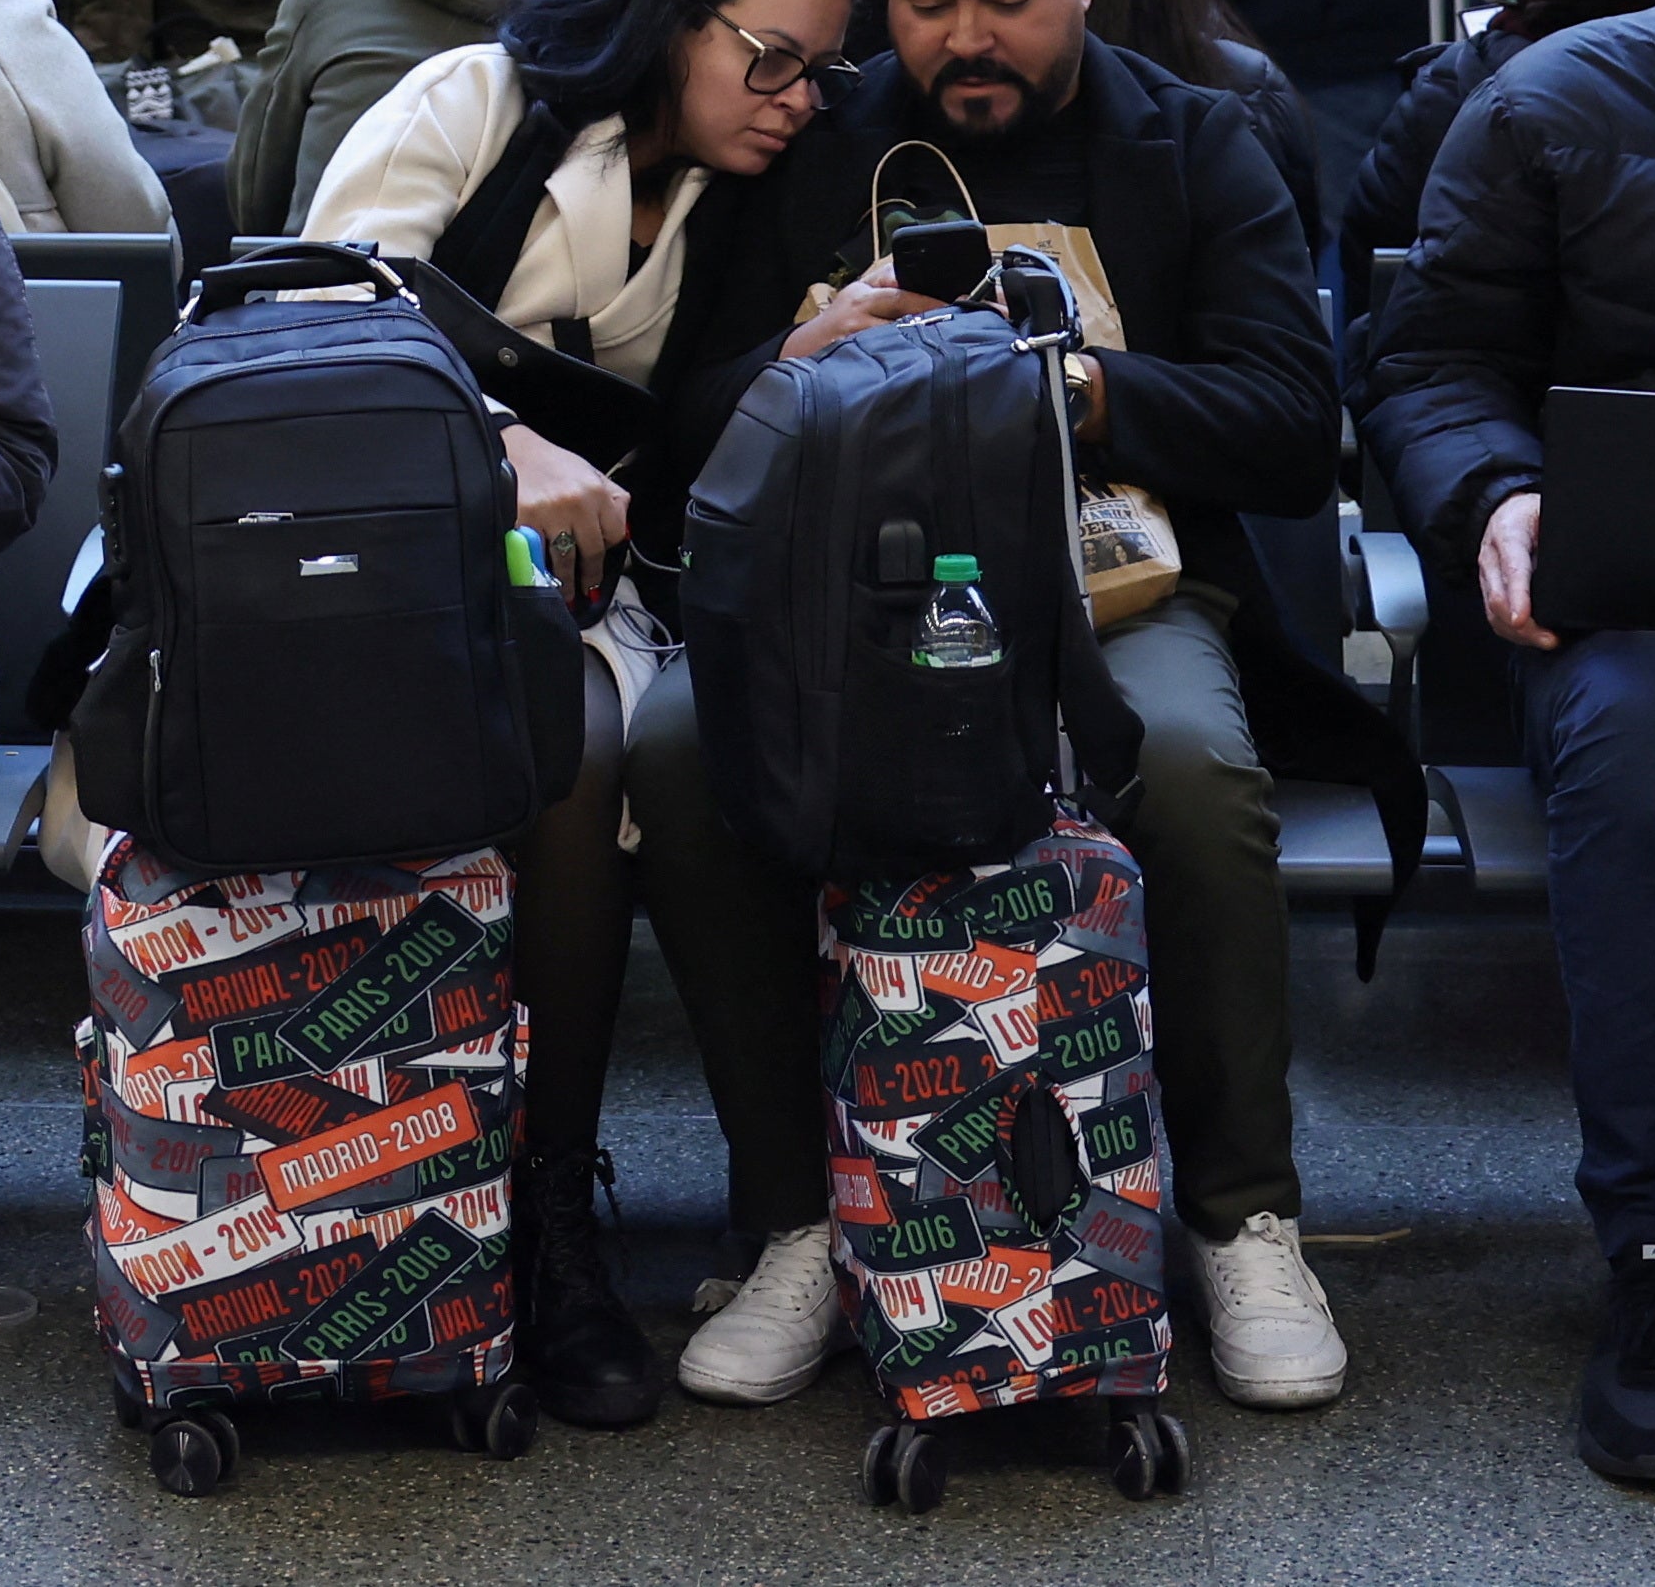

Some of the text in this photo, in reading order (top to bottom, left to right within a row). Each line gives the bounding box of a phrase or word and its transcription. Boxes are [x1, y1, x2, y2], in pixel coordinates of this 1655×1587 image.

[301, 919, 455, 1054] PARIS-2016
[279, 1102, 457, 1194] MADRID-2008
[218, 1204, 287, 1262] 2014
